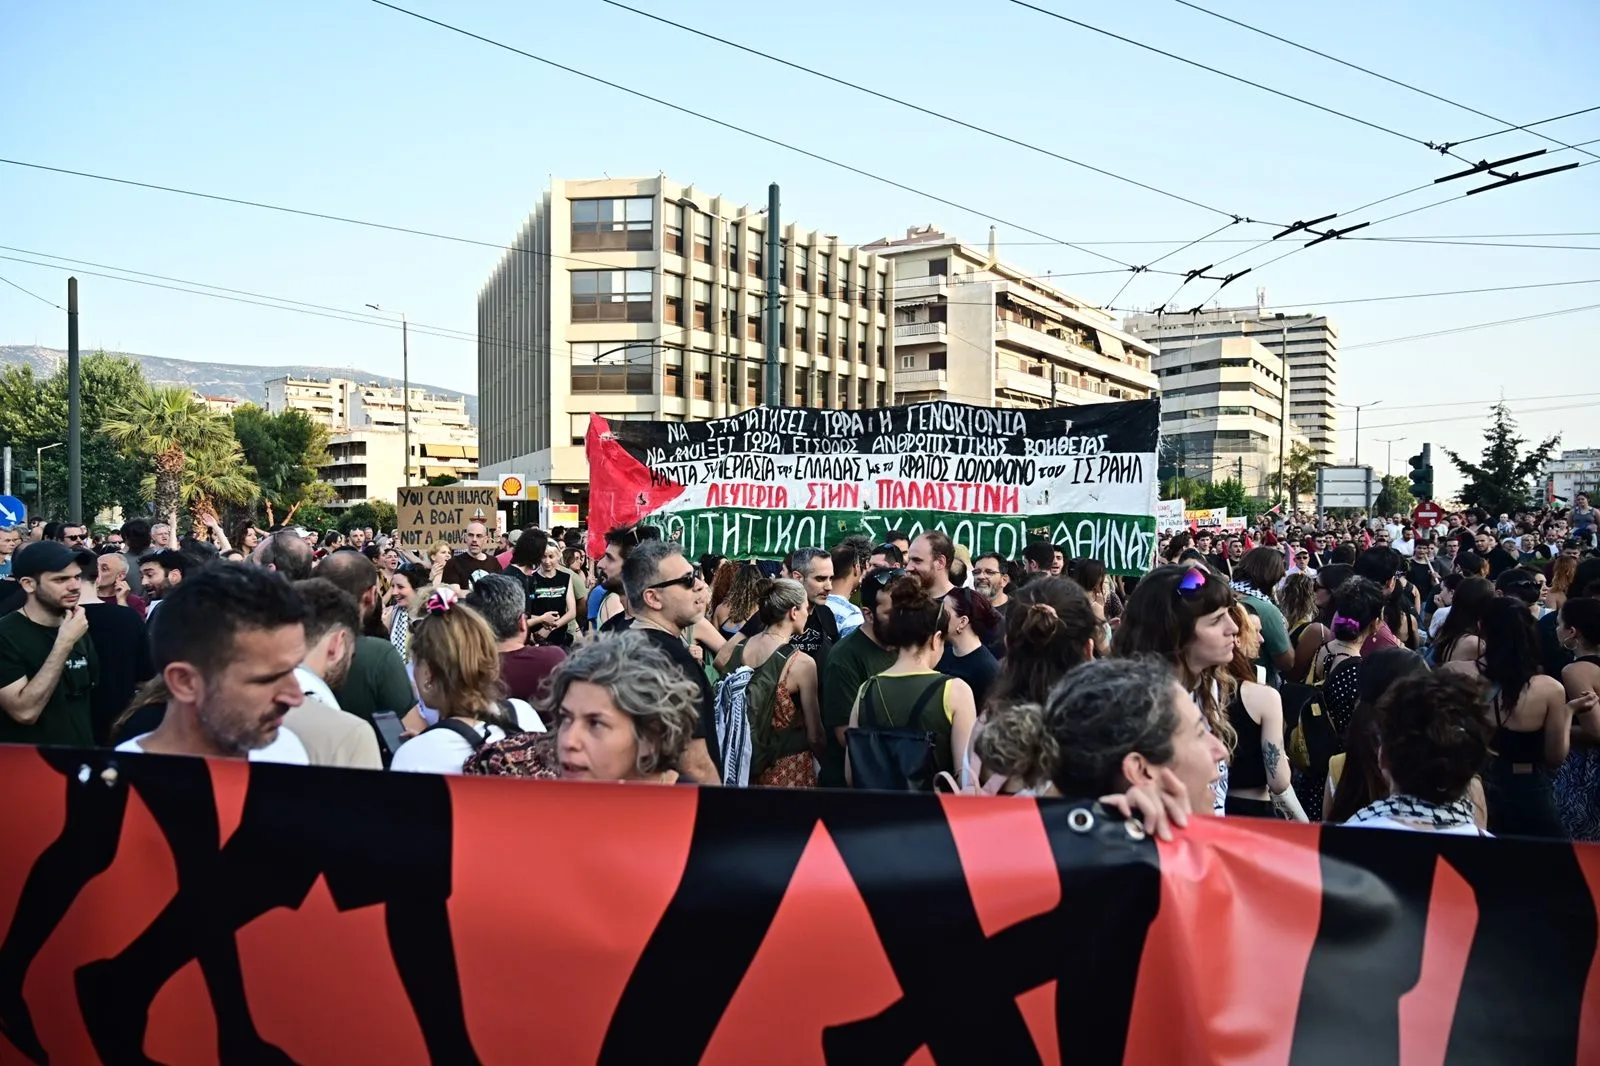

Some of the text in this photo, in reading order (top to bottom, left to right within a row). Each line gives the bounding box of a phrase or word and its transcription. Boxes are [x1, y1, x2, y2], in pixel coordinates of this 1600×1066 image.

[668, 423, 690, 443] ΝΑ
[821, 411, 864, 437] ΤΩΡΑ
[879, 410, 892, 433] Η
[907, 402, 1026, 436] ΓΕΝΟΚΤΟΝΙΑ
[646, 447, 666, 466] ΝΑ
[744, 431, 781, 453] ΤΩΡΑ
[793, 436, 859, 454] ΕΙΣΟΔΟΣ
[872, 432, 1010, 456] ΑΝΘΡΩΠΙΣΤΙΚΗΣ
[1023, 434, 1110, 456] ΒΟΗΘΕΙΑΣ
[649, 464, 698, 487] ΚΑΜΙΑ
[795, 456, 864, 481] ΕΛΛΑΔΑΣ
[899, 454, 951, 481] ΚΡΑΤΟΣ
[955, 457, 1036, 486] ΔΟΛΟΦΟΝΟ
[1038, 465, 1066, 478] του
[1071, 454, 1142, 484] ΙΣΡΑΗΛ
[400, 490, 494, 507] YOU CAN HIJACK
[706, 479, 1019, 513] ΛΕΥΤΕΡΙΑ ΣΤΗΝ ΠΑΛΑΙΣΤΙΝΗ
[413, 508, 464, 525] A BOAT
[400, 530, 423, 545] NOT
[425, 531, 434, 544] A
[439, 527, 497, 544] MOUVET
[1051, 518, 1154, 571] ΑΘΗΝΑΣ
